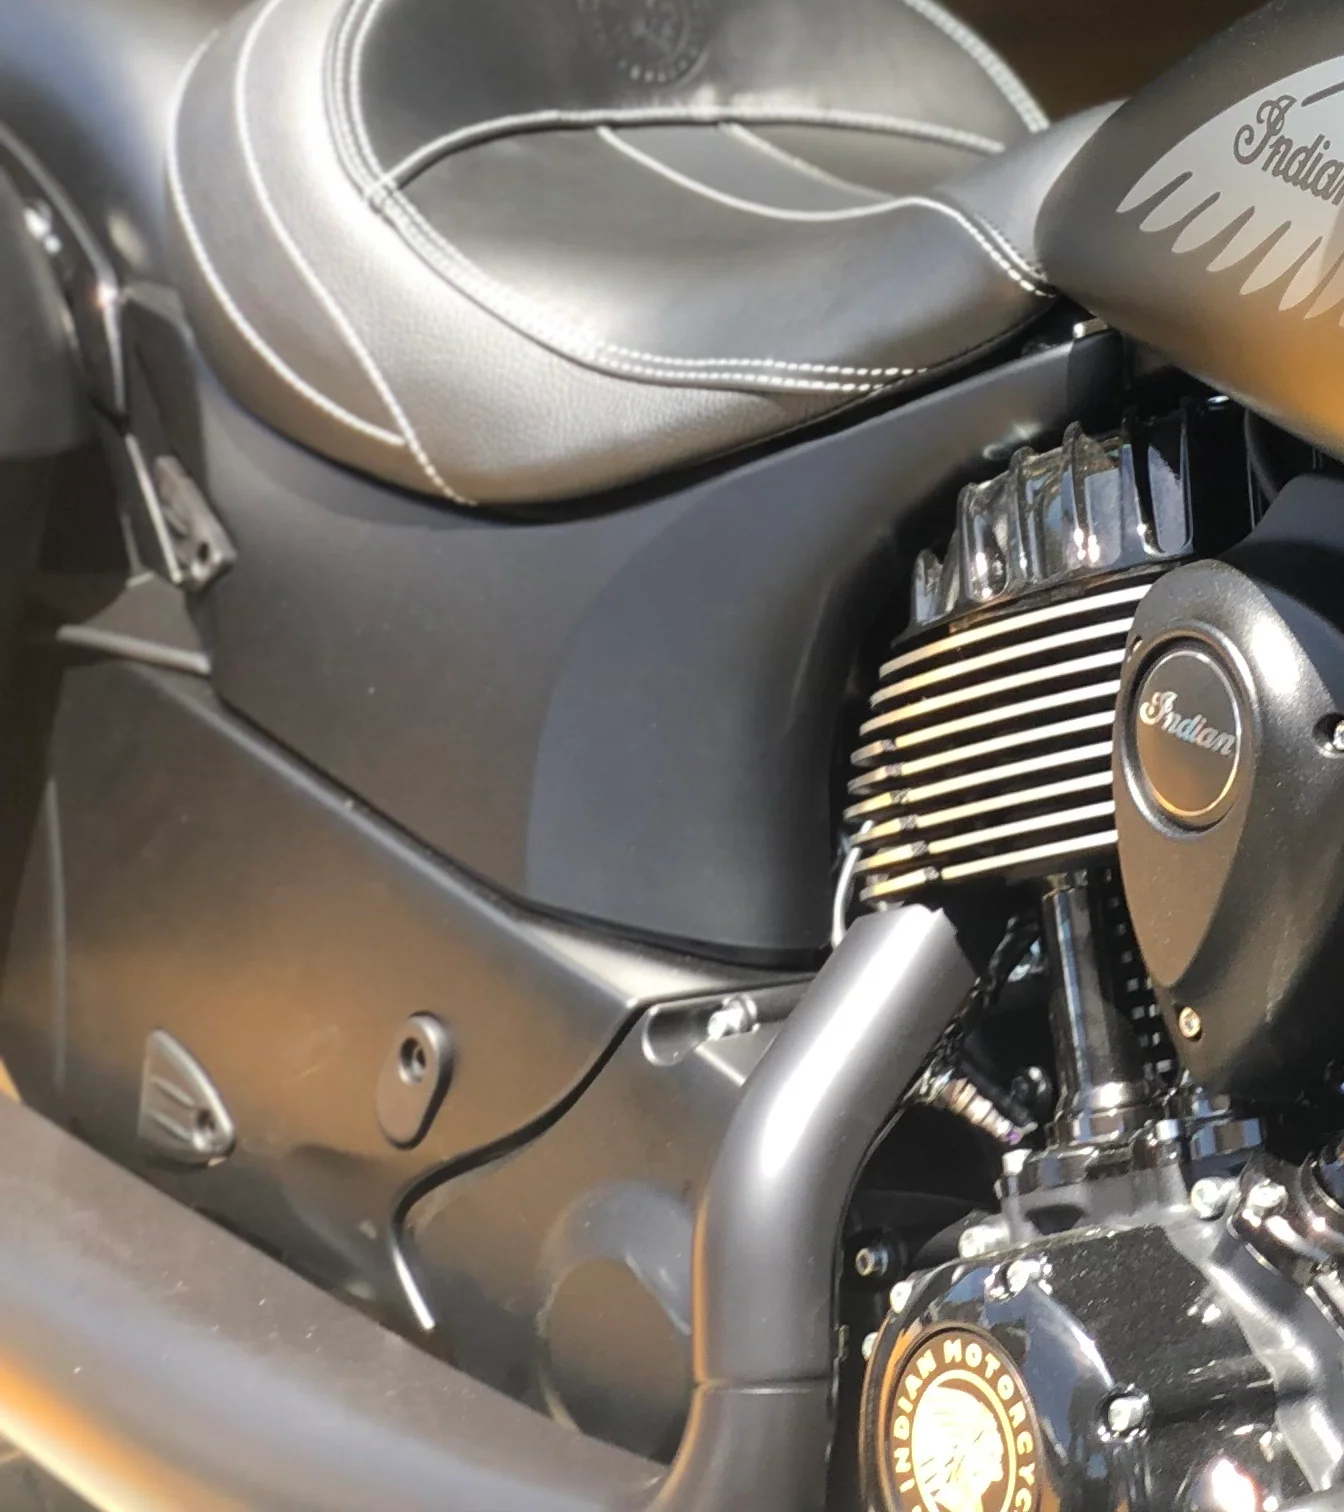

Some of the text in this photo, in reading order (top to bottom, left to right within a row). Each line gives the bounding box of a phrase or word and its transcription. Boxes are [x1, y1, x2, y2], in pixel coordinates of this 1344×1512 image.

[1139, 691, 1235, 755] Indian
[893, 1338, 1036, 1512] INDIAN MOTORCYC
